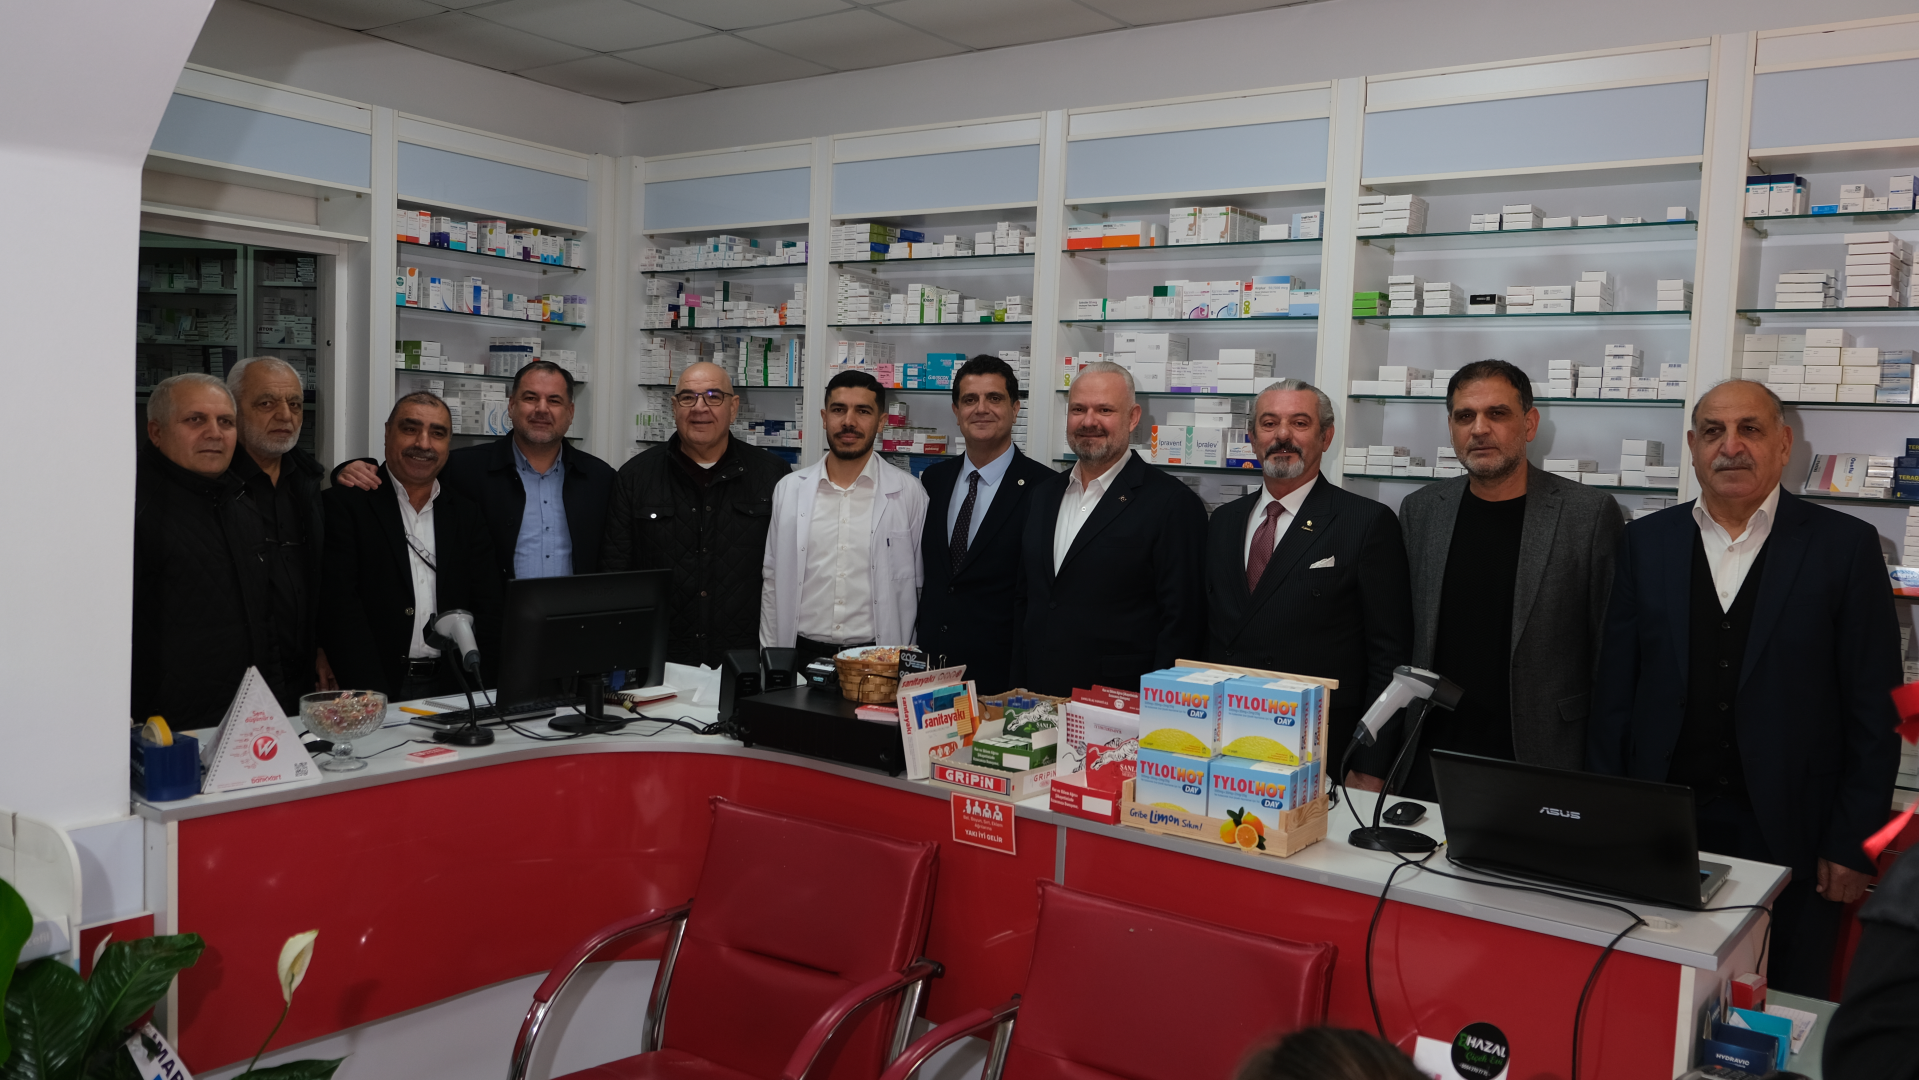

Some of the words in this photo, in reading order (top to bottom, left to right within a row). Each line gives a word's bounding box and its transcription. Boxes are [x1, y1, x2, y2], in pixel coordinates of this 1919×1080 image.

[1143, 687, 1210, 709] TYLOLHOT
[1227, 693, 1298, 716] TYLOLHOT
[924, 709, 966, 729] sanitayakı
[1190, 710, 1205, 718] DAY
[1277, 717, 1292, 726] DAY
[1140, 760, 1204, 785] TYLOLHOT
[1184, 785, 1199, 794] DAY
[1213, 774, 1286, 799] TYLOLHOT
[1264, 800, 1280, 808] DAY
[1130, 808, 1148, 819] Gribe
[1149, 810, 1179, 826] Limon
[1539, 807, 1581, 820] ASUS
[965, 829, 977, 837] YAKI
[1465, 1034, 1506, 1058] HAZAL
